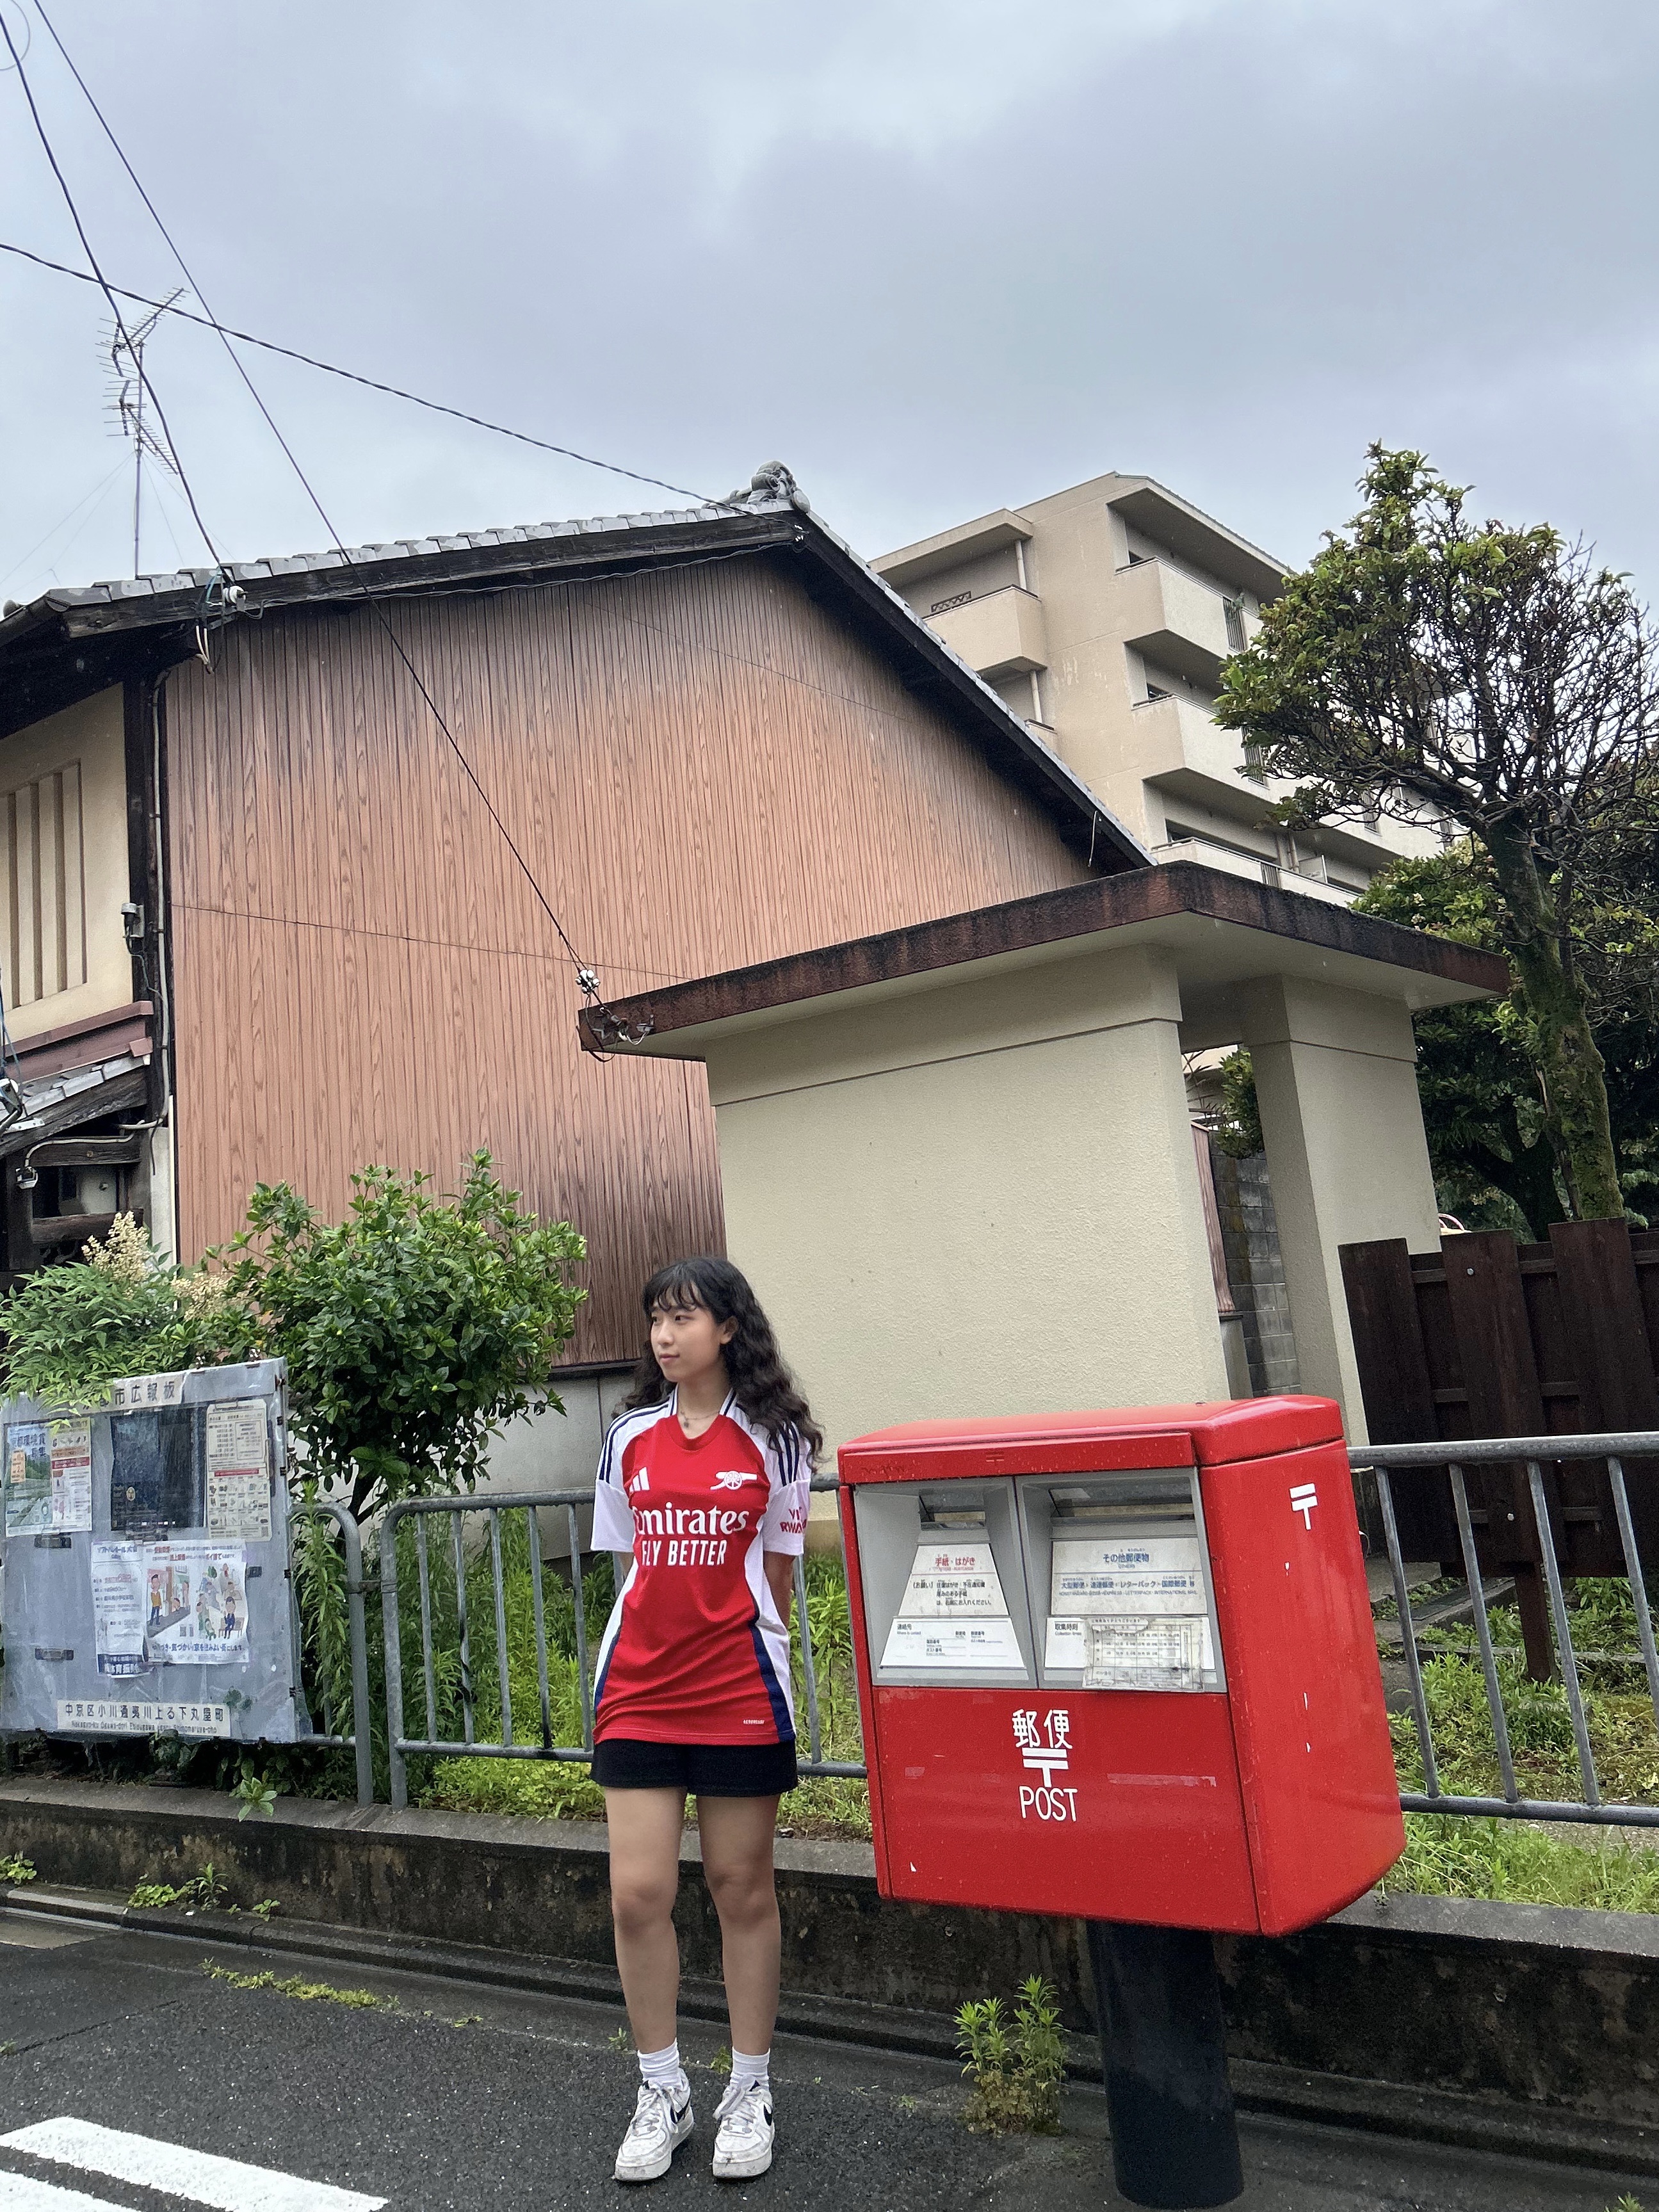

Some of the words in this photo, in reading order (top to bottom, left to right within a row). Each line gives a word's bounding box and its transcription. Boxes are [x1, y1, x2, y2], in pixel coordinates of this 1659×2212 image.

[642, 1540, 662, 1566] FLY
[667, 1539, 727, 1566] BETTER
[1103, 1553, 1149, 1563] その他郵便物
[65, 1702, 223, 1722] 中京区小川通夷川上る下丸屋町
[1012, 1709, 1072, 1749] 郵便
[1019, 1786, 1078, 1822] POST
